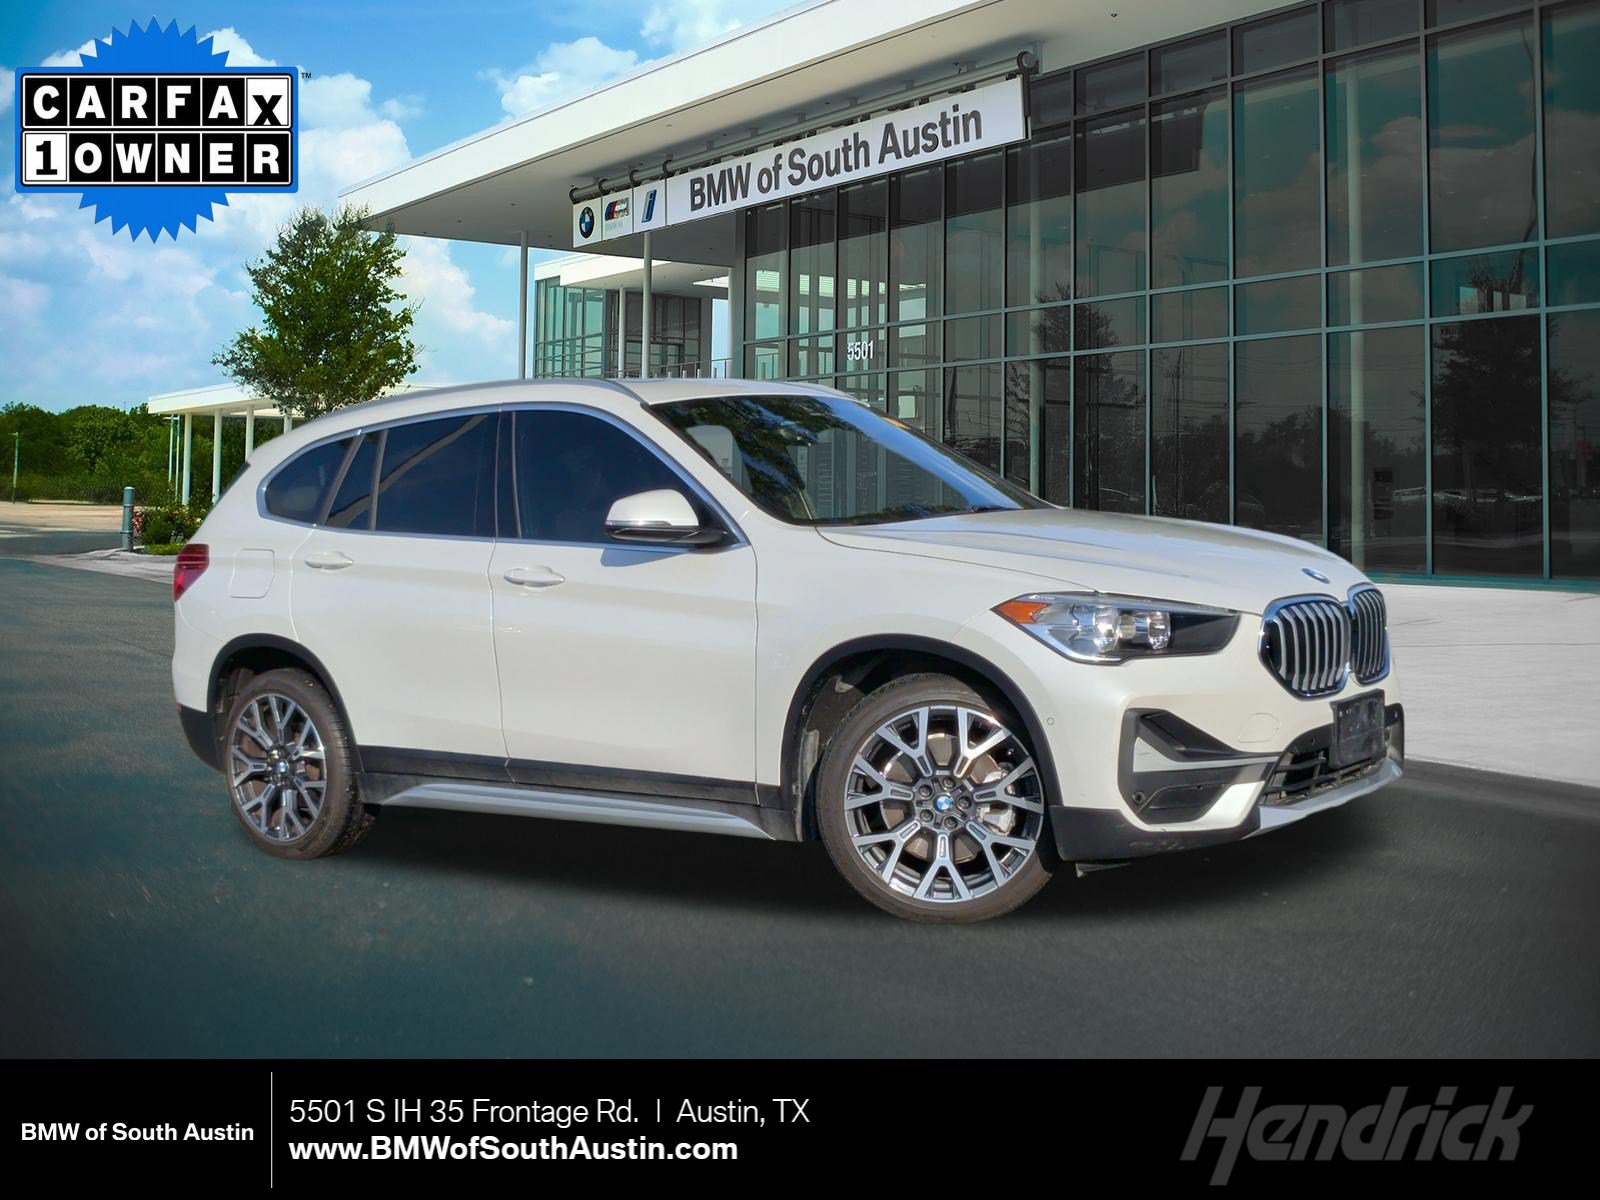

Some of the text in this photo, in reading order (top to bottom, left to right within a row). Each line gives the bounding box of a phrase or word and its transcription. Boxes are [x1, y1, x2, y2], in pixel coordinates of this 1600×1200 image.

[690, 104, 982, 211] BMW of South Austin
[847, 340, 874, 361] 5501
